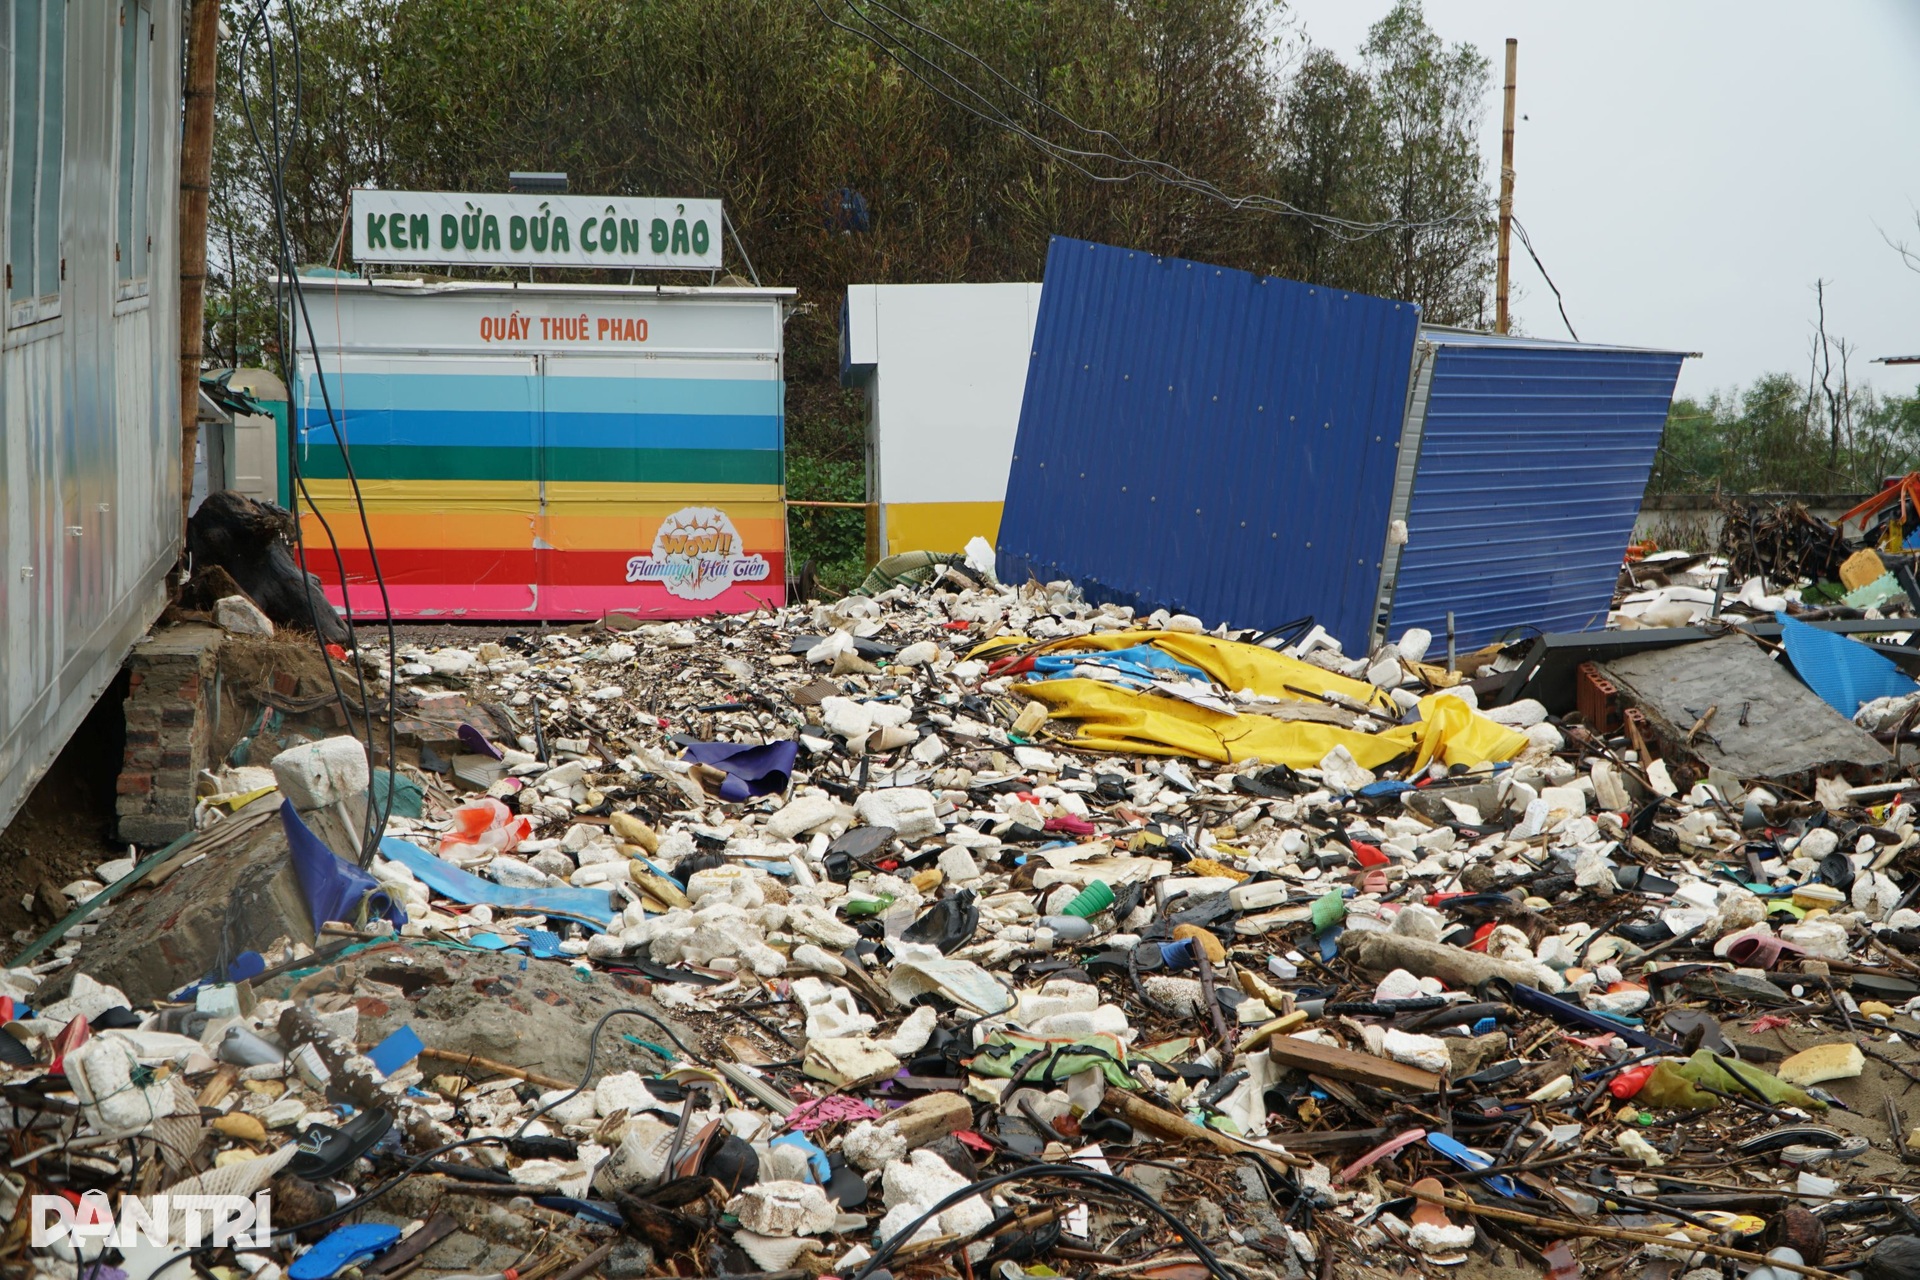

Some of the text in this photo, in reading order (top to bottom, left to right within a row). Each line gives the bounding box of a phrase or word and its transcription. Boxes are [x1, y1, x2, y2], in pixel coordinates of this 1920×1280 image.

[368, 202, 710, 255] KEM DỪA DỨA CÔN ĐẢO
[480, 311, 648, 342] QUẦY THUÊ PHAO
[629, 560, 694, 580] Flamingo
[733, 557, 764, 577] Tiến
